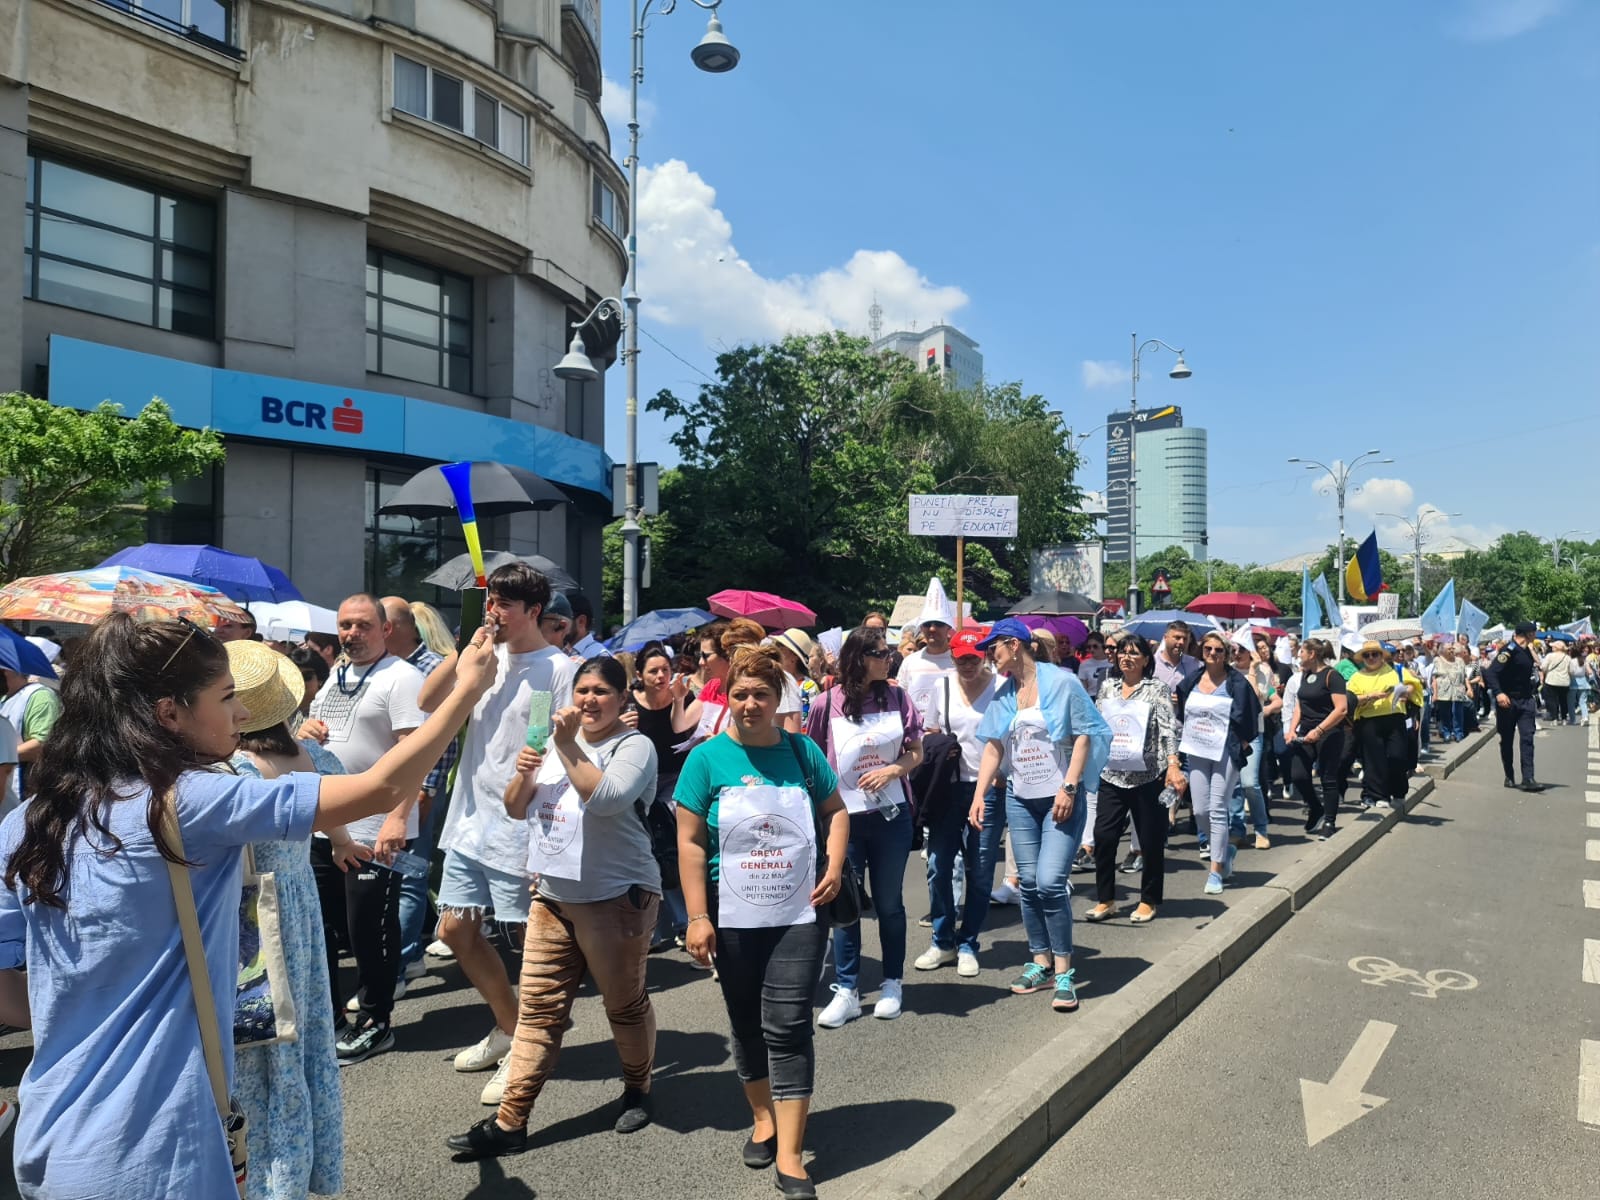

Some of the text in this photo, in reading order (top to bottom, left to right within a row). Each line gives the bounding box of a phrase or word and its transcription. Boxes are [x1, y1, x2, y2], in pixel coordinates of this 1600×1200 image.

[262, 396, 327, 430] BCR
[922, 509, 939, 517] NU
[921, 521, 936, 531] PE
